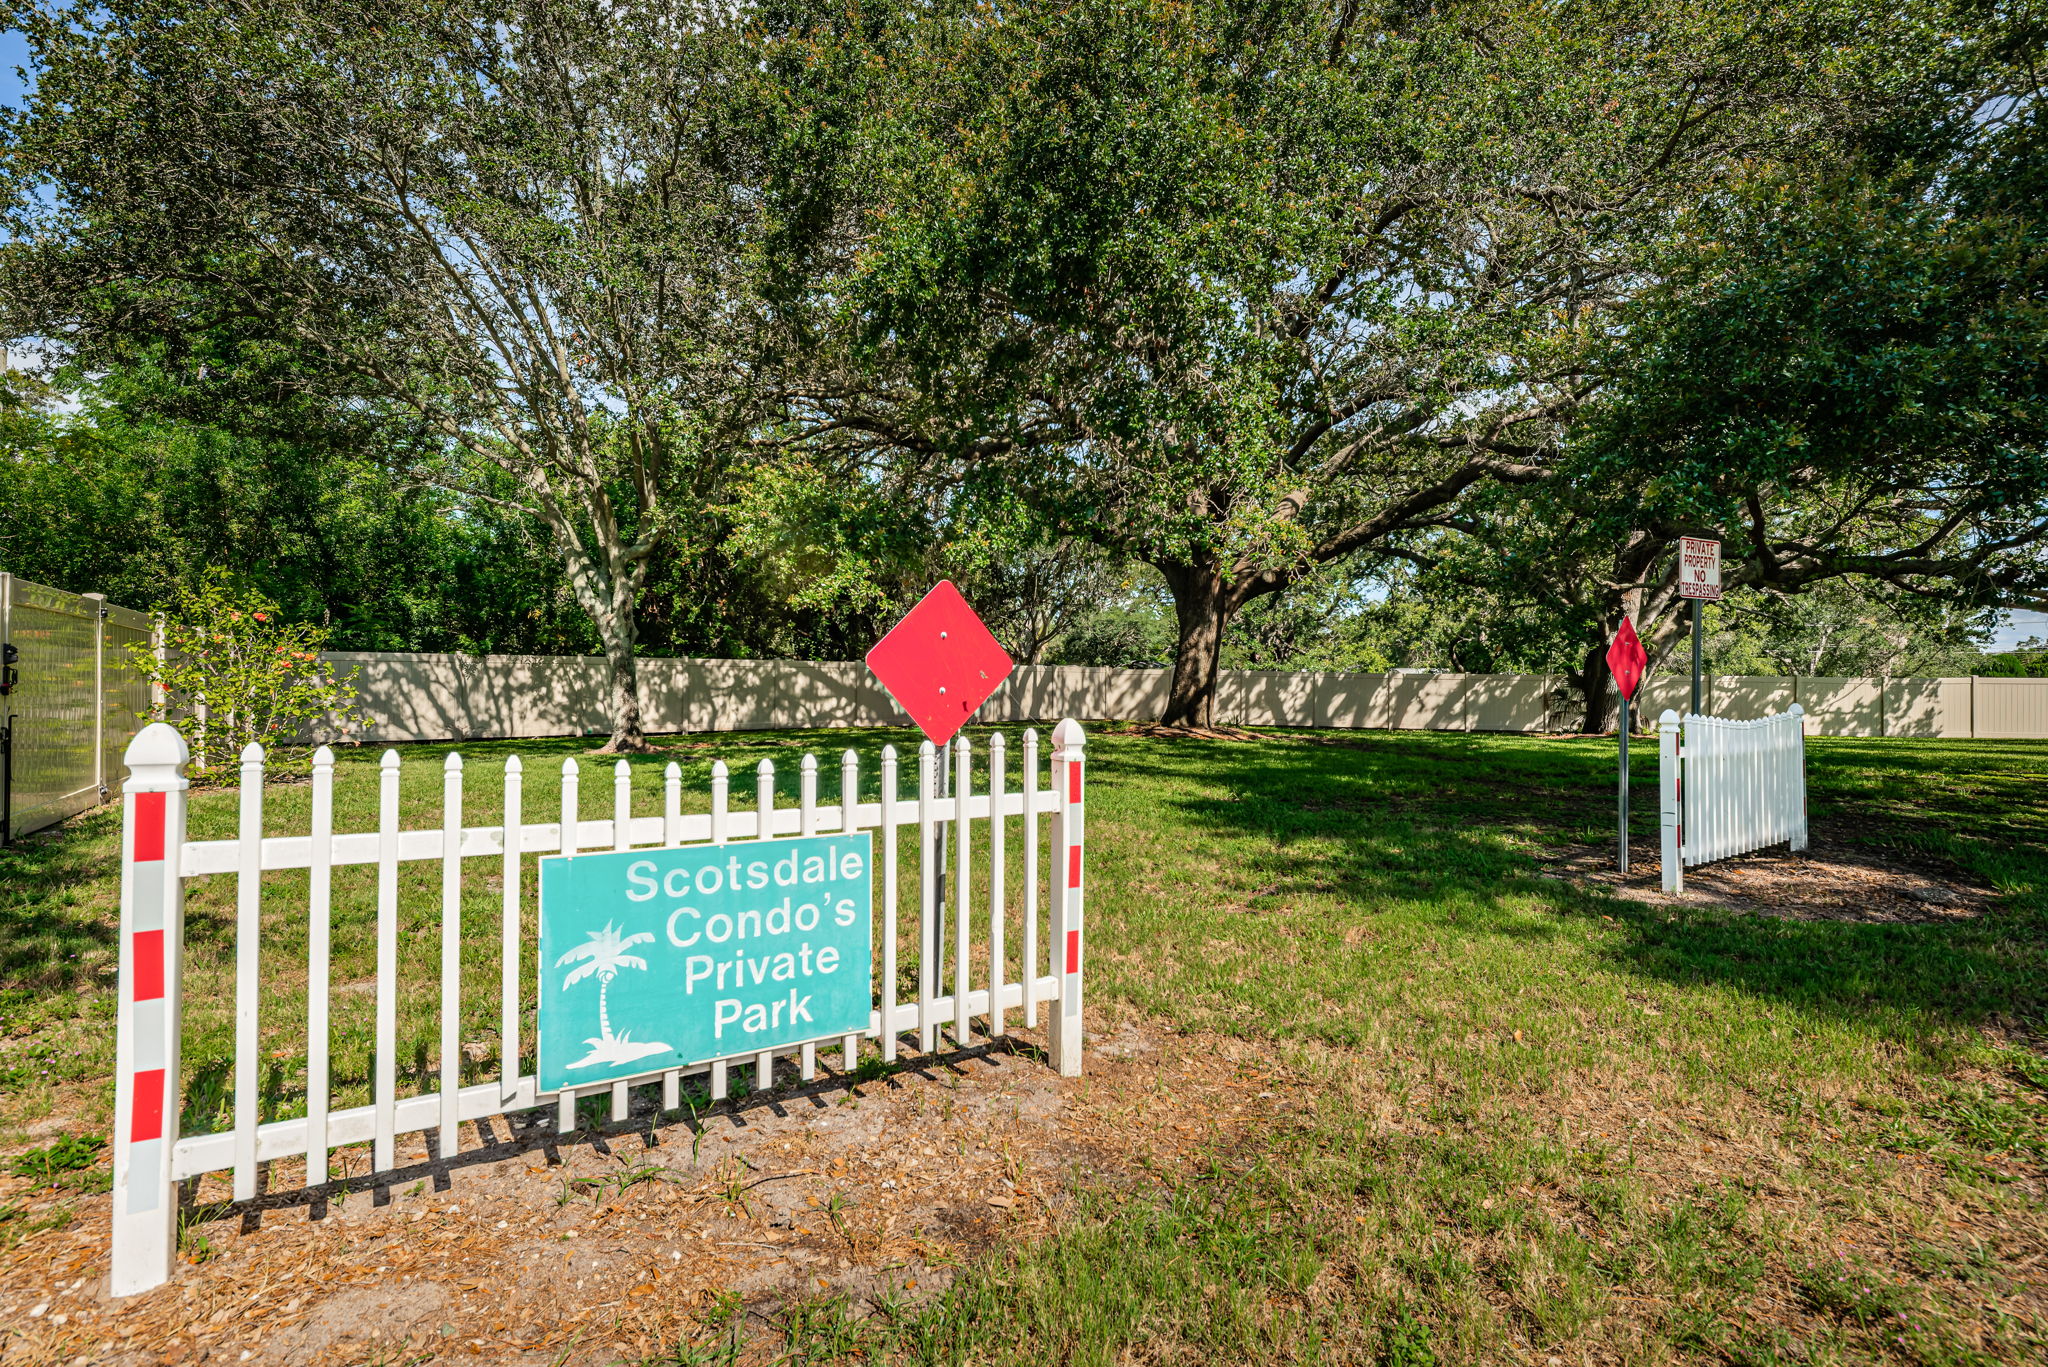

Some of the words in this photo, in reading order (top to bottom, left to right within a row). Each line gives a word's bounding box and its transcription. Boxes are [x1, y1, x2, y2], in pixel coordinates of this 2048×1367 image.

[1684, 554, 1716, 569] PROPERTY
[1685, 541, 1714, 555] PRIVATE
[1682, 582, 1719, 596] TRESPASSING
[1694, 569, 1706, 582] NO
[625, 845, 864, 902] Scotsdale
[666, 892, 856, 948] Condo's
[685, 942, 840, 995] Private
[714, 988, 814, 1039] Park
